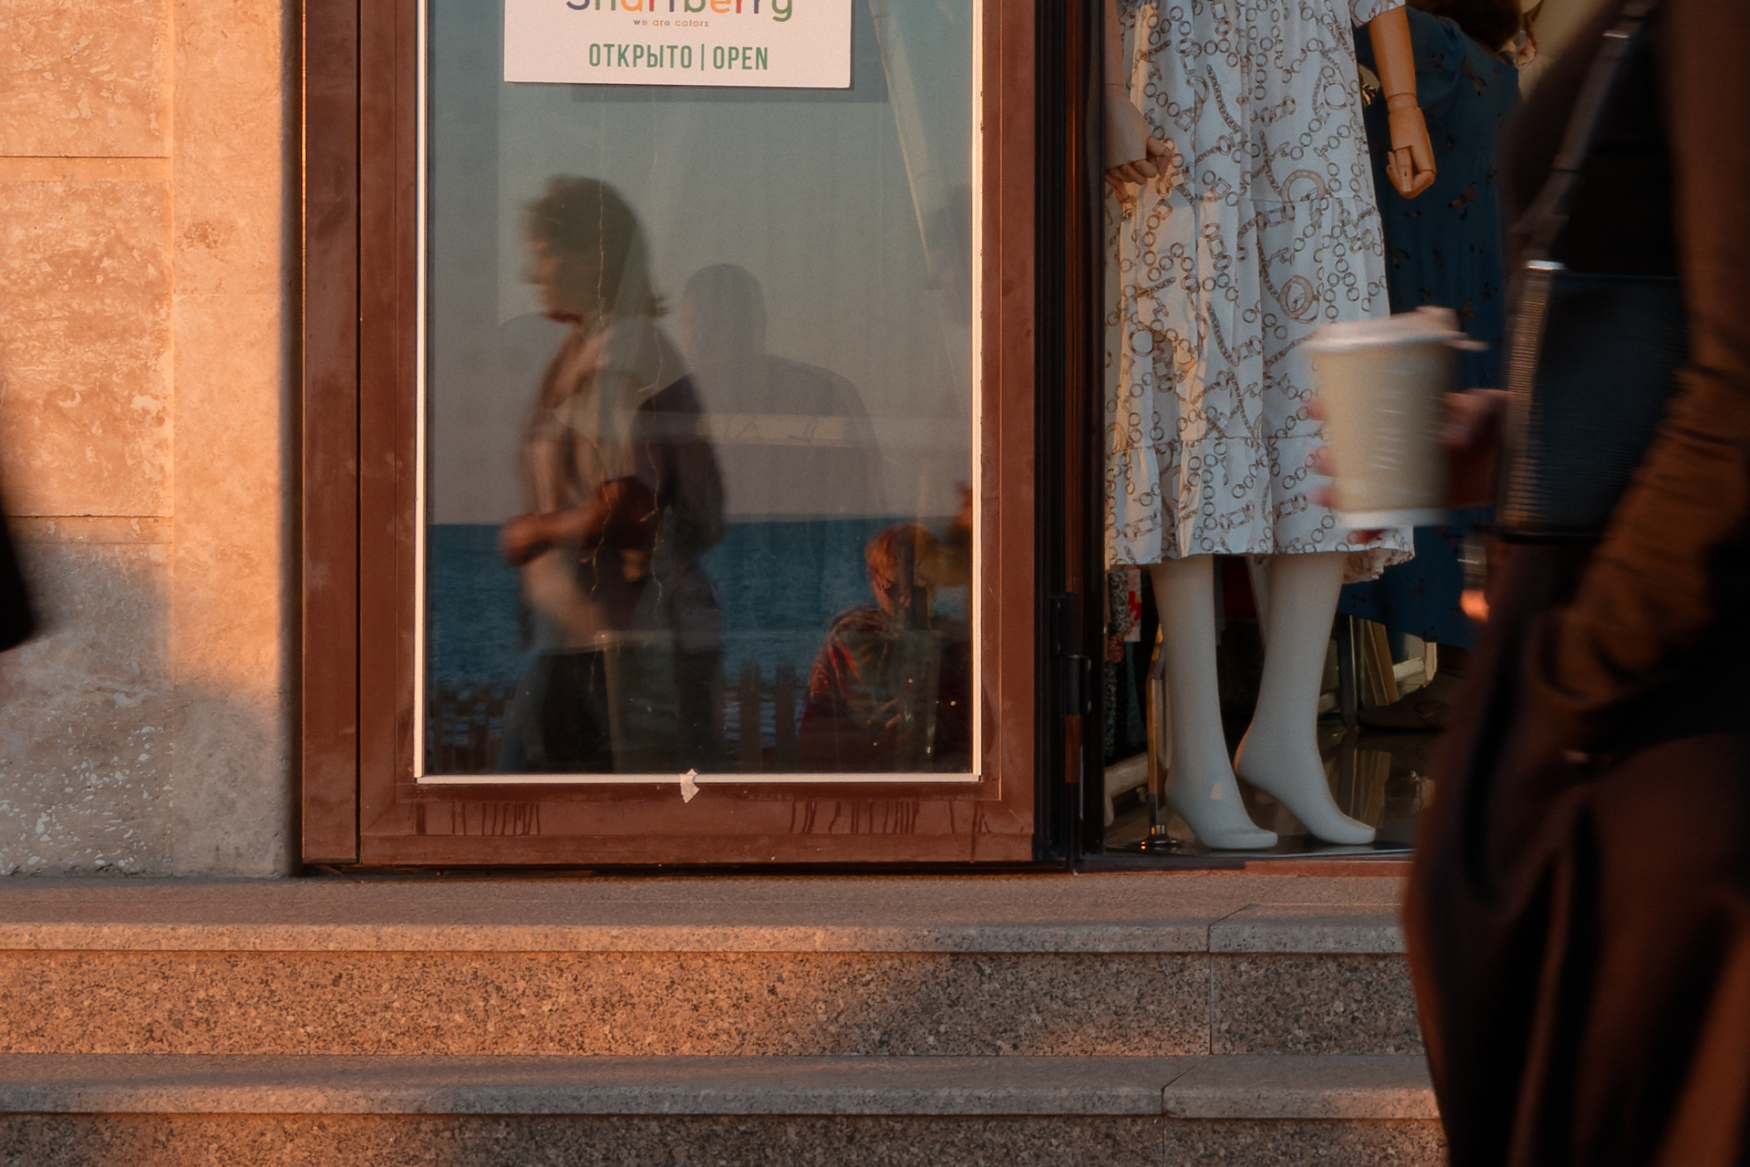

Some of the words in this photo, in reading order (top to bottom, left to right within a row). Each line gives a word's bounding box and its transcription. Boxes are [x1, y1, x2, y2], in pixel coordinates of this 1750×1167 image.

[652, 19, 671, 27] are
[674, 19, 709, 28] colors
[589, 43, 692, 69] ОТКРЫТО
[713, 46, 768, 70] OPEN
